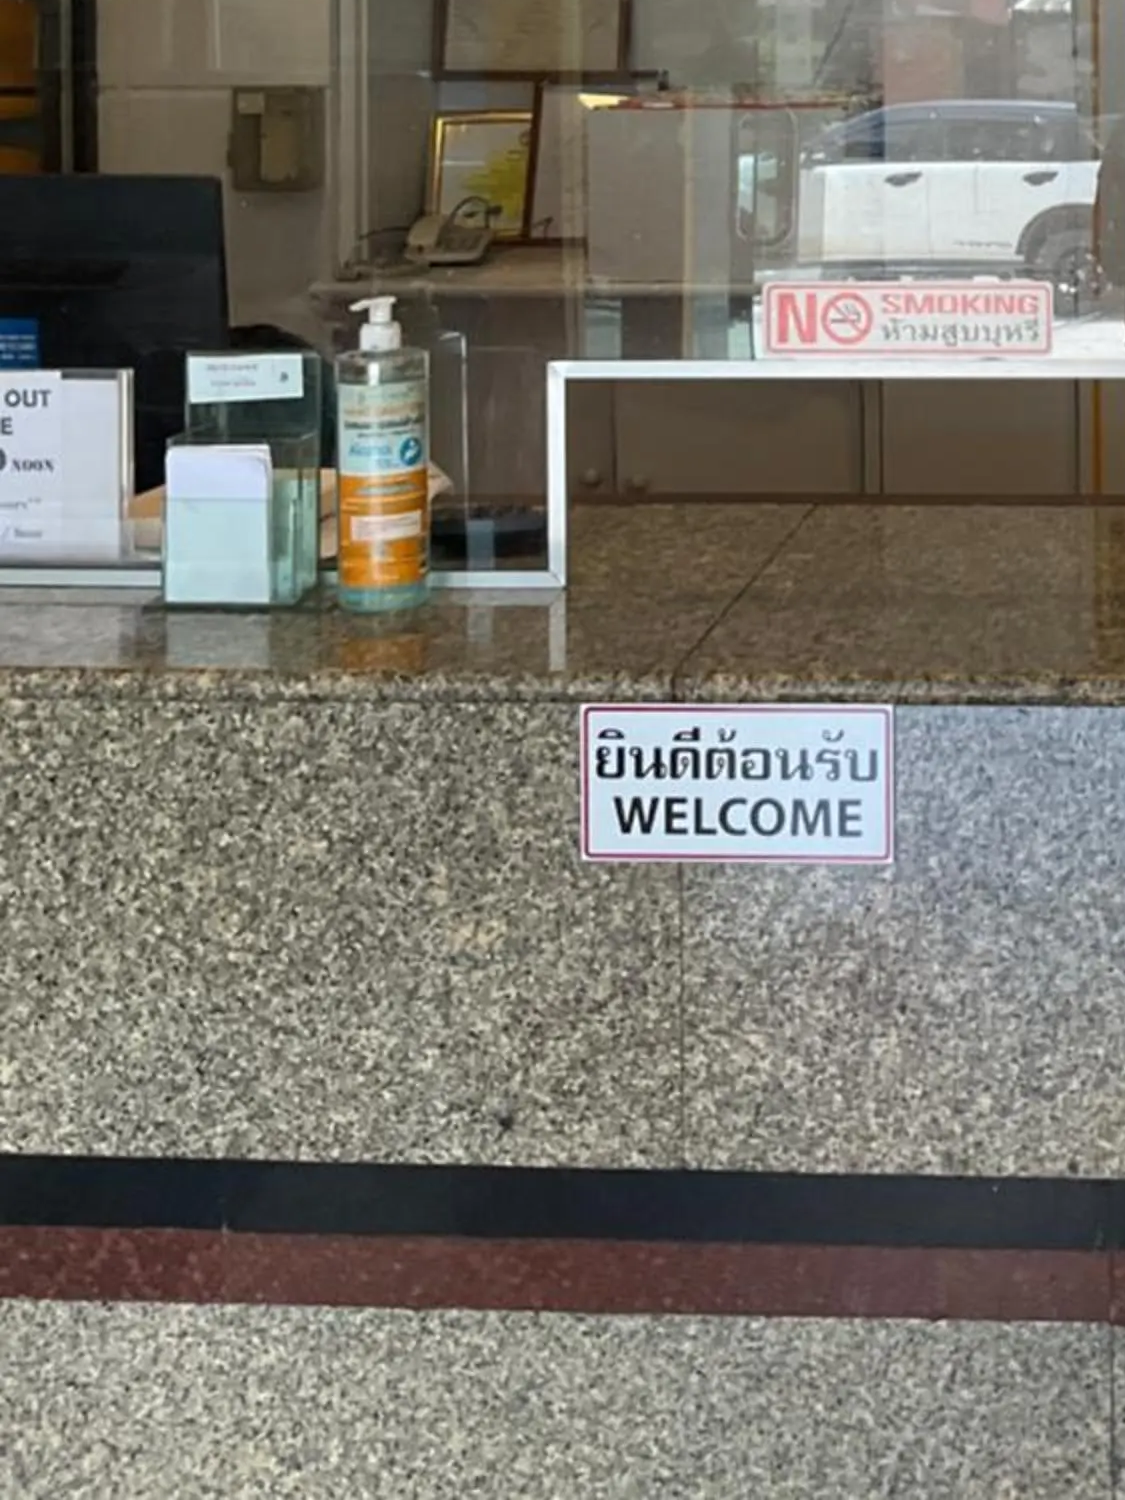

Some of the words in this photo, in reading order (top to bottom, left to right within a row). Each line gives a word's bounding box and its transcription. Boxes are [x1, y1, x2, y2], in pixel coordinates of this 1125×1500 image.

[881, 293, 1039, 314] SMOKING
[5, 389, 52, 408] OUT
[596, 727, 878, 782] ยินดีต้อนรับ
[613, 797, 863, 837] WELCOME
